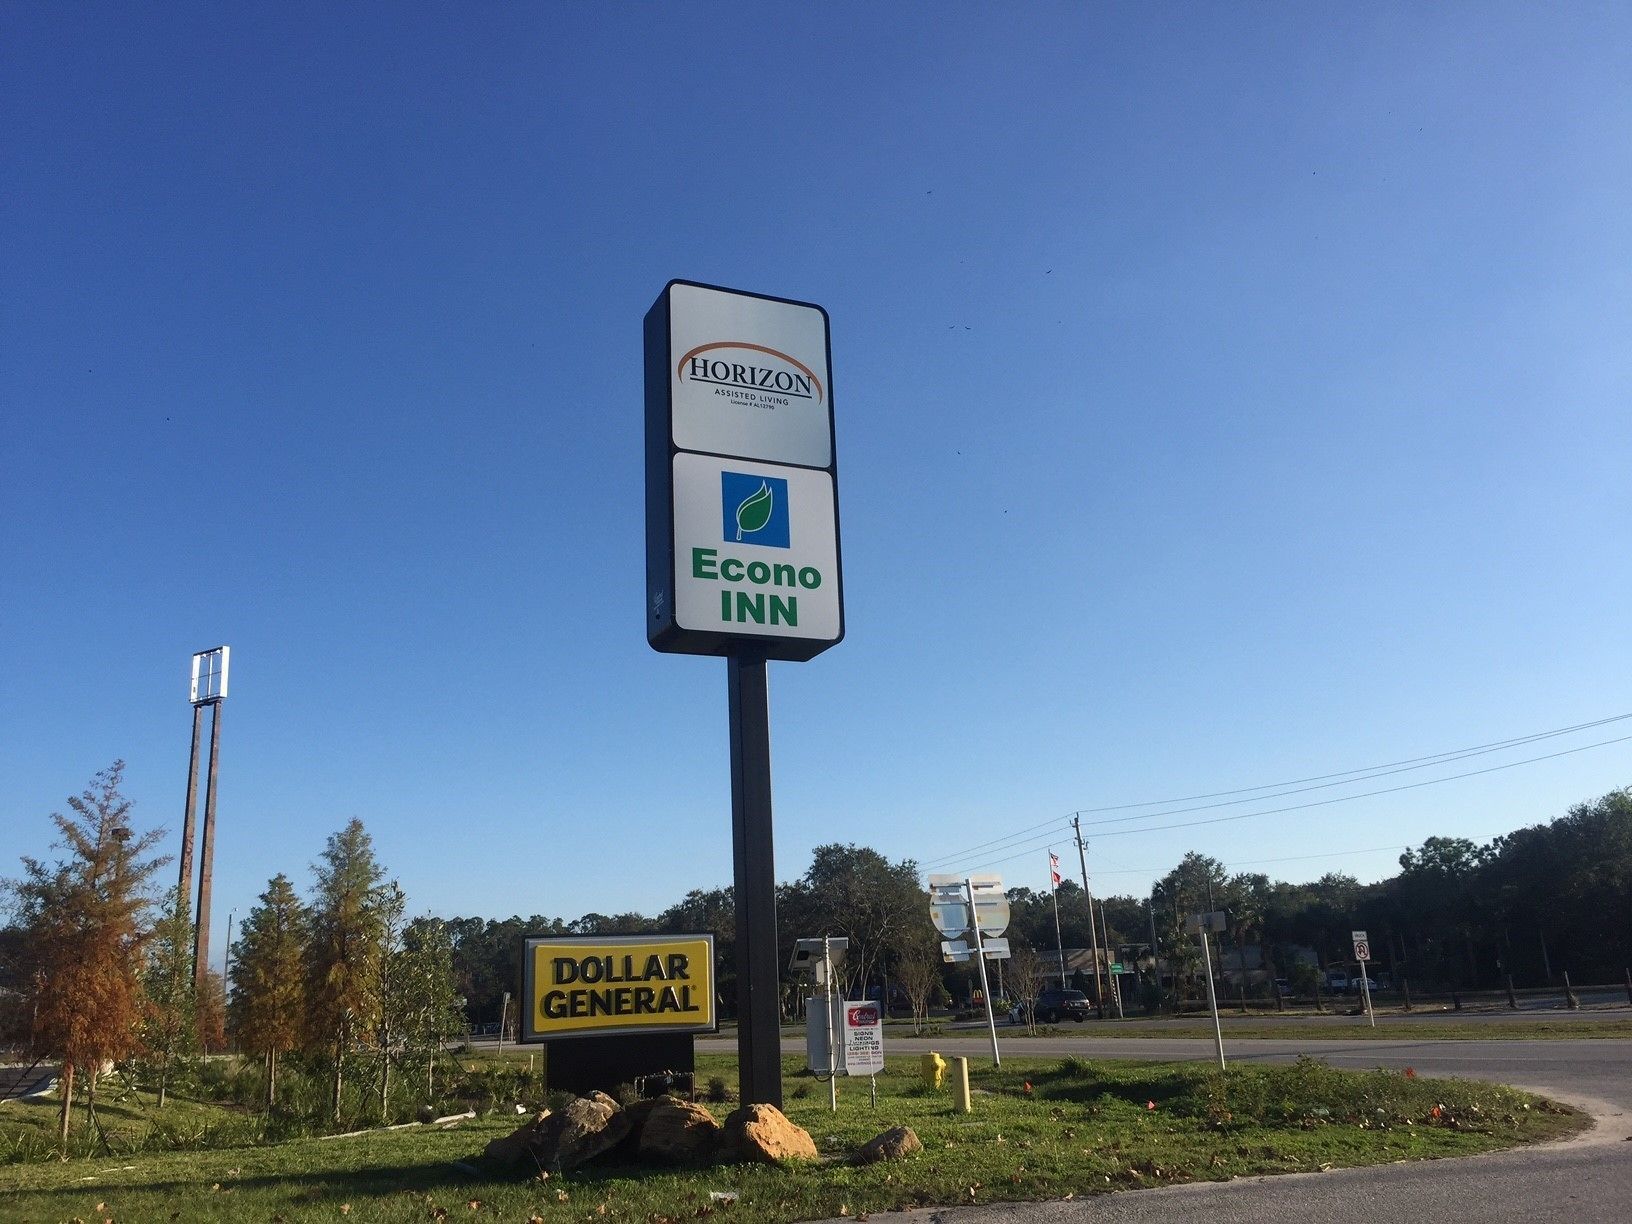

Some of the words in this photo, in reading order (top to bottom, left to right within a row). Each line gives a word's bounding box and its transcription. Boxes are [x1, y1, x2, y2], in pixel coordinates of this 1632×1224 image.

[689, 357, 812, 395] HORIZON
[714, 388, 757, 401] ASSISTED
[759, 396, 789, 406] LIVING
[692, 547, 822, 590] Econo
[721, 590, 798, 627] INN
[553, 953, 691, 985] DOLLAR
[542, 985, 699, 1019] GENERAL
